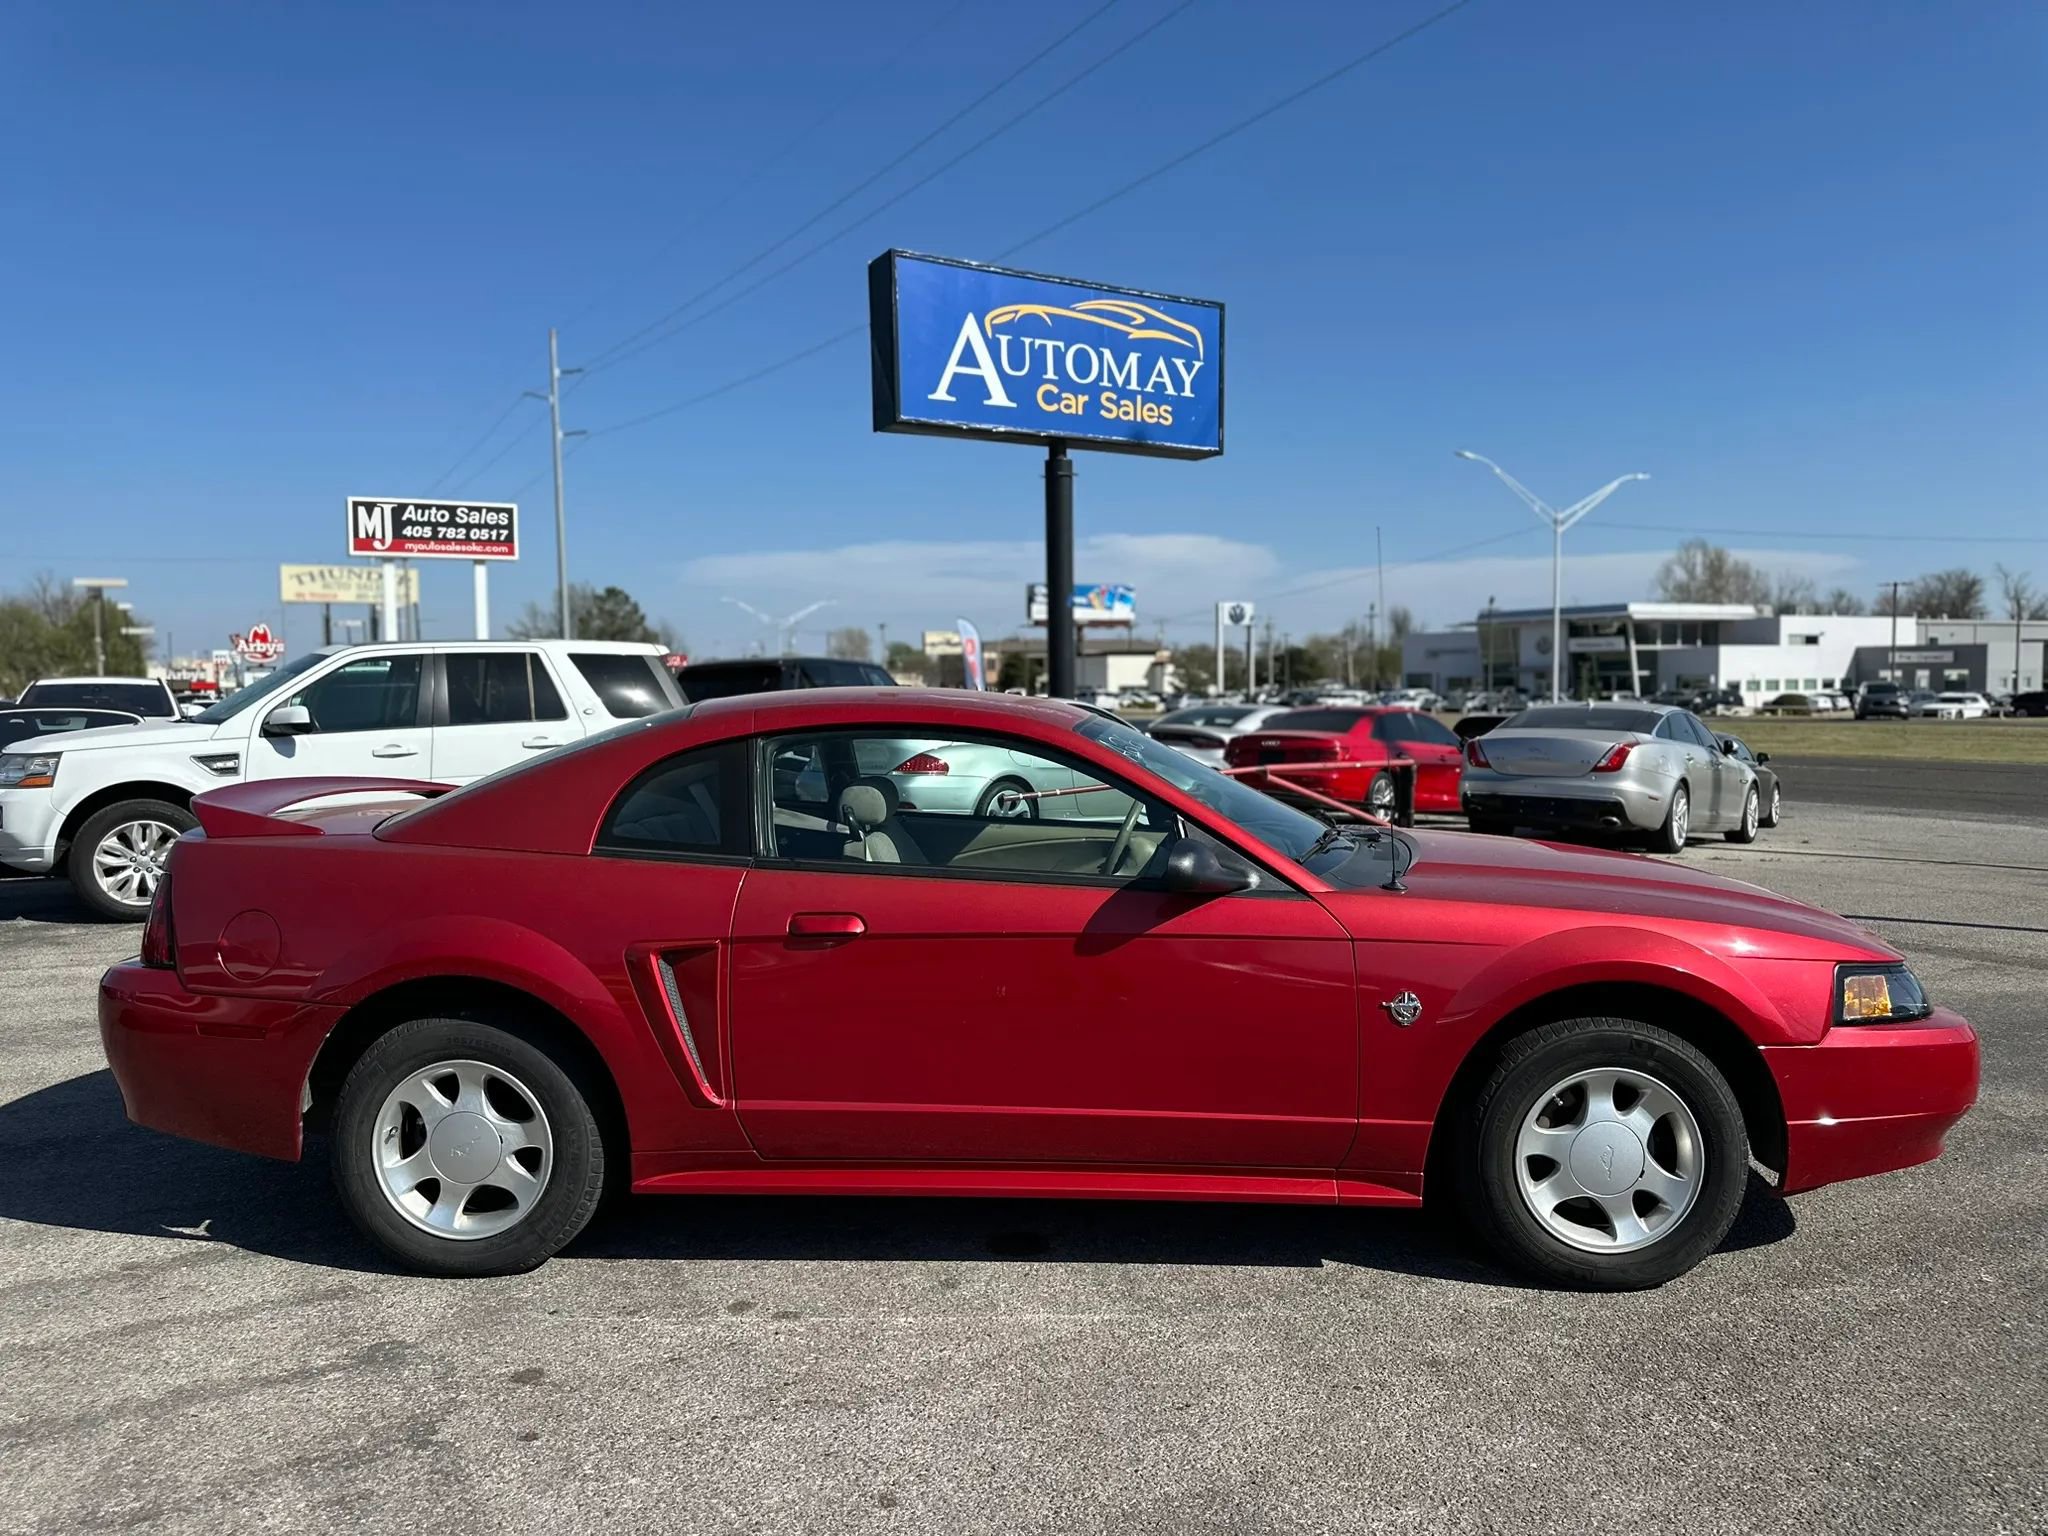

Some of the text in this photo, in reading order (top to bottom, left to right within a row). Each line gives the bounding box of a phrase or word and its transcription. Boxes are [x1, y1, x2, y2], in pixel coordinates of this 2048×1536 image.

[927, 312, 1204, 408] AUTOMAY
[1036, 384, 1173, 426] Car Sales
[401, 504, 509, 525] Auto Sales
[357, 503, 398, 550] MJ
[402, 525, 509, 541] 405 782 0517
[404, 541, 509, 553] mjautosalesokc.com
[237, 639, 285, 655] Arby's
